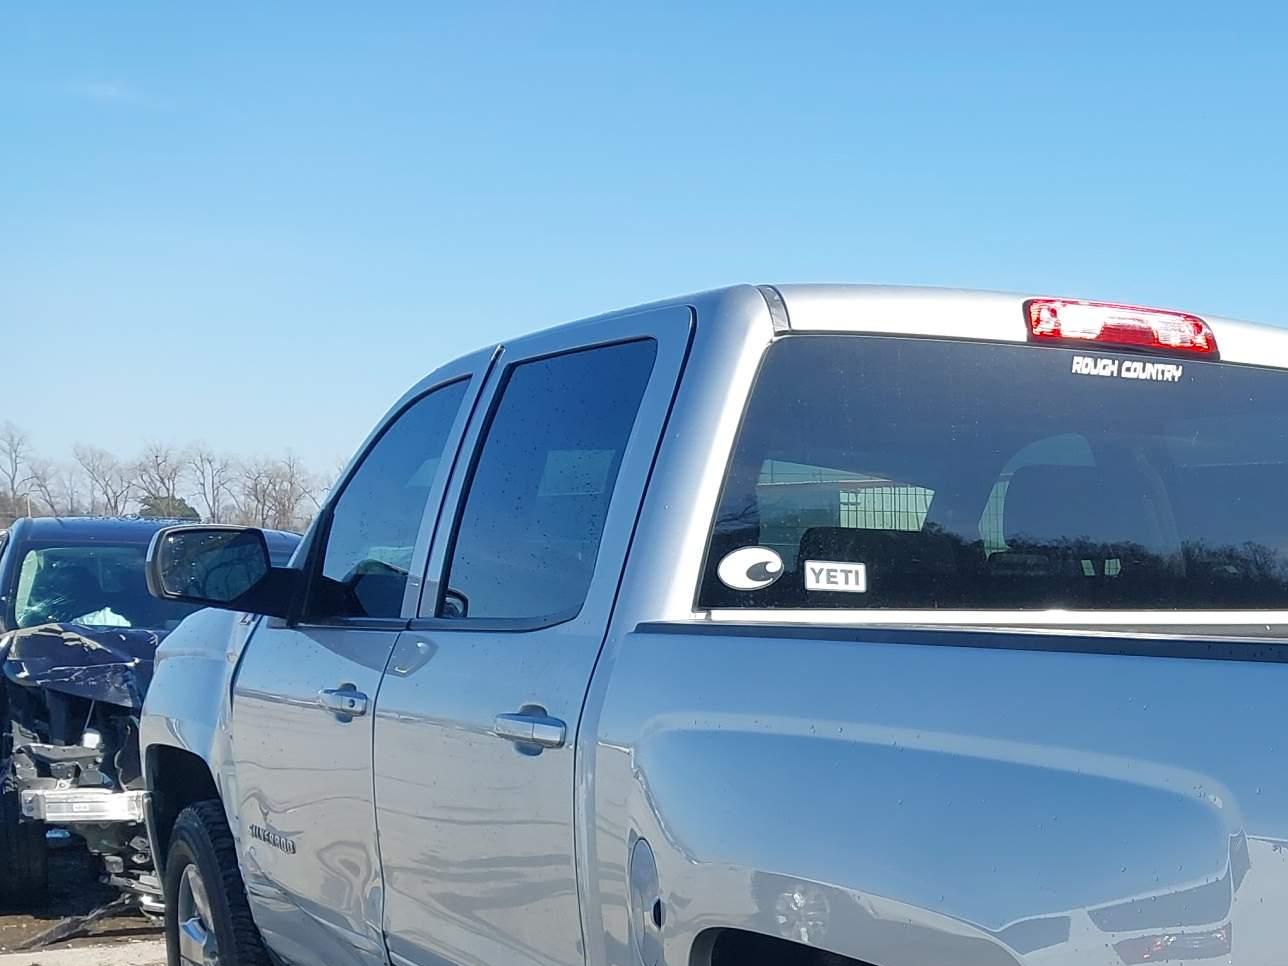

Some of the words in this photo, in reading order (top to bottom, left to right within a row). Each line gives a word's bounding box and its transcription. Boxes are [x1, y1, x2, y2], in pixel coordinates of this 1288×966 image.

[1071, 355, 1119, 377] ROUGH
[1121, 360, 1183, 382] COUNTRY
[809, 567, 861, 586] YETI
